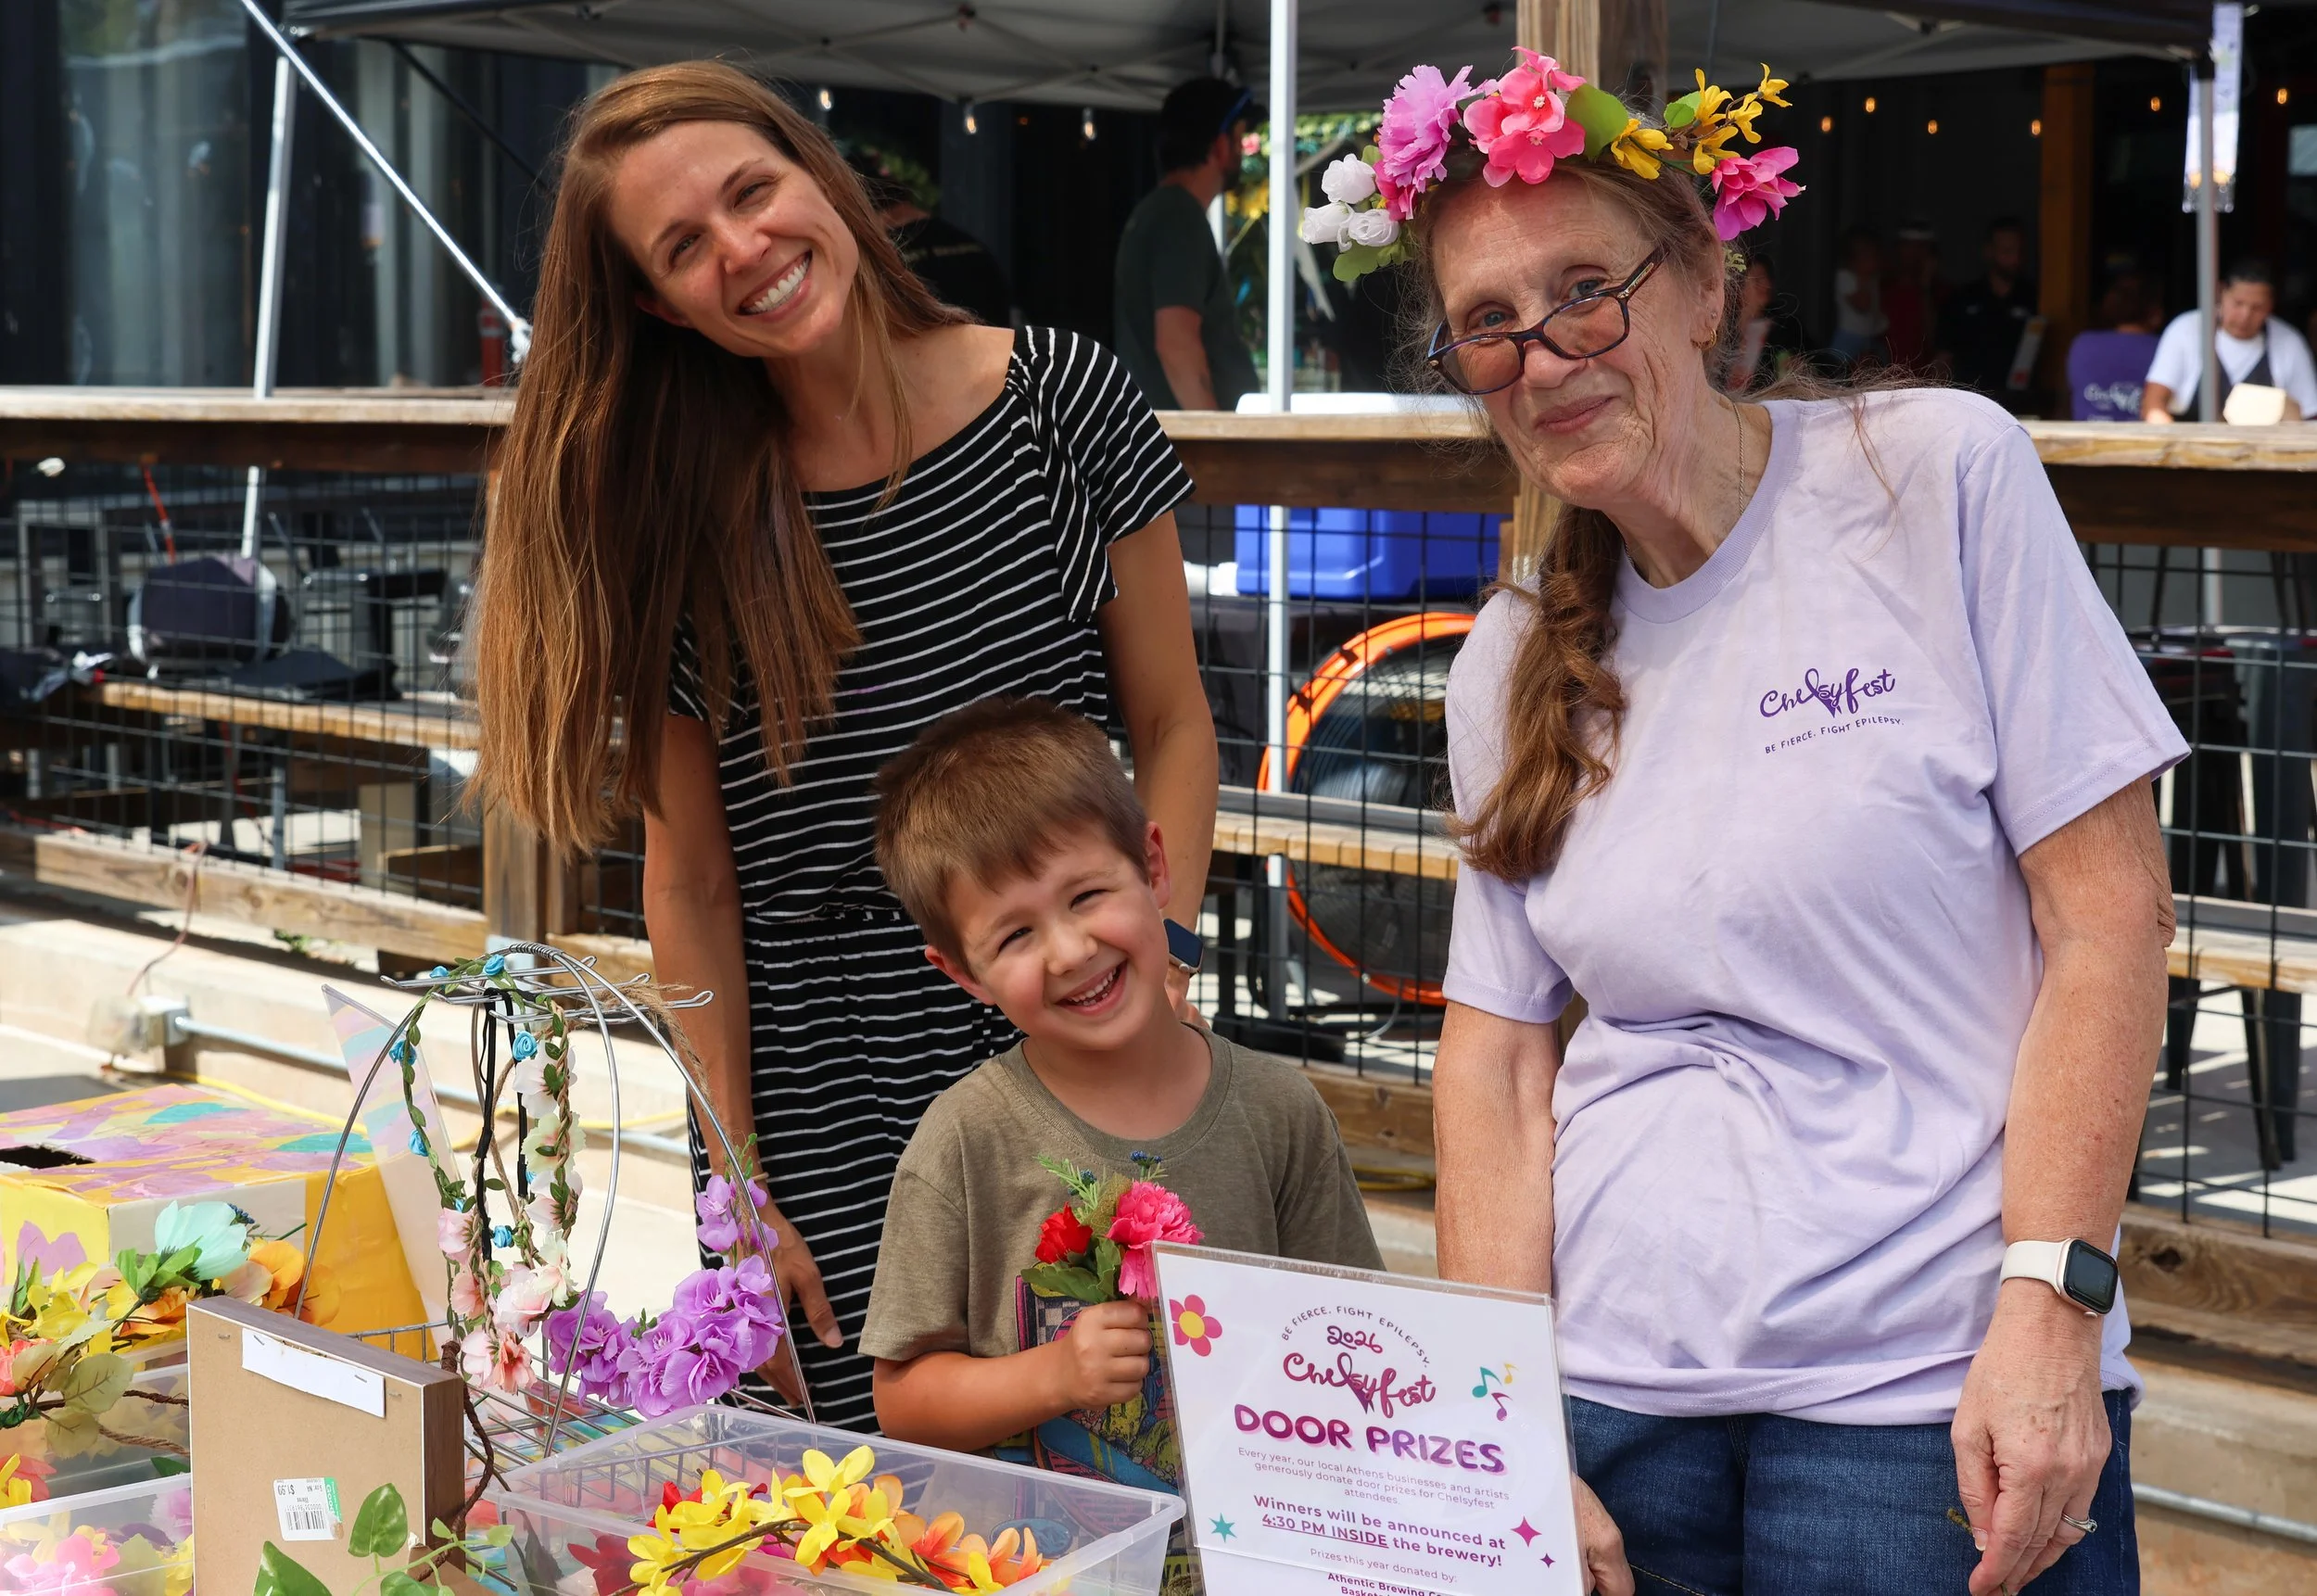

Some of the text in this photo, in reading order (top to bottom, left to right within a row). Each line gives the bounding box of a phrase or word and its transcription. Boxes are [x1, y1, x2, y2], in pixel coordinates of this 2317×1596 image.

[1759, 667, 1896, 718] Chelsyfest
[1765, 716, 1905, 754] BE FIERCE. FIGHT EPILEPSY.
[1282, 1306, 1430, 1368] BE FIERCE. FIGHT EPILEPSY.
[1326, 1325, 1383, 1354] 2026
[1283, 1352, 1437, 1419] Chelsyfest
[1234, 1404, 1506, 1474] DOOR PRIZES
[1238, 1447, 1510, 1501] Every year, our local Athens businesses and artists
[1255, 1462, 1495, 1510] generously donate door prizes for Chelsyfest
[1344, 1488, 1400, 1505] attendees.
[1254, 1495, 1506, 1550] Winners will be announced at
[1262, 1514, 1502, 1568] 4:30 PM INSIDE the brewery!
[1310, 1548, 1458, 1583] Prizes this year donated by:
[1327, 1573, 1375, 1589] Athentic
